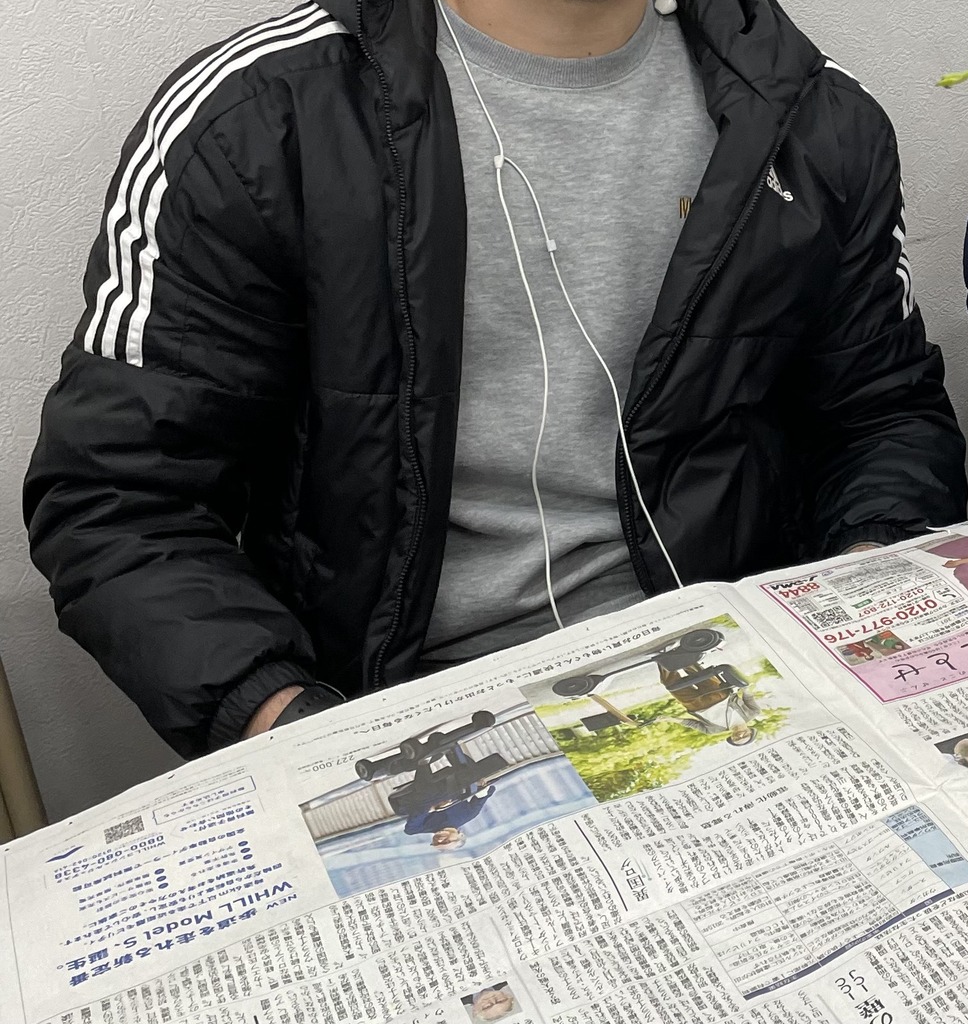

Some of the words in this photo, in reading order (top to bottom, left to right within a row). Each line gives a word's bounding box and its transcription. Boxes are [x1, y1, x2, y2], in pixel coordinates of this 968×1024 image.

[780, 581, 821, 599] 8844
[858, 588, 924, 618] 0120-172-807
[824, 600, 938, 644] 0120-977-176
[54, 834, 164, 880] 0800-080-4338
[617, 856, 650, 903] 異国ログ
[220, 880, 293, 913] WHILL
[266, 893, 298, 910] NEW
[142, 911, 213, 941] Model
[69, 907, 259, 988] 歩道を走れる新定番
